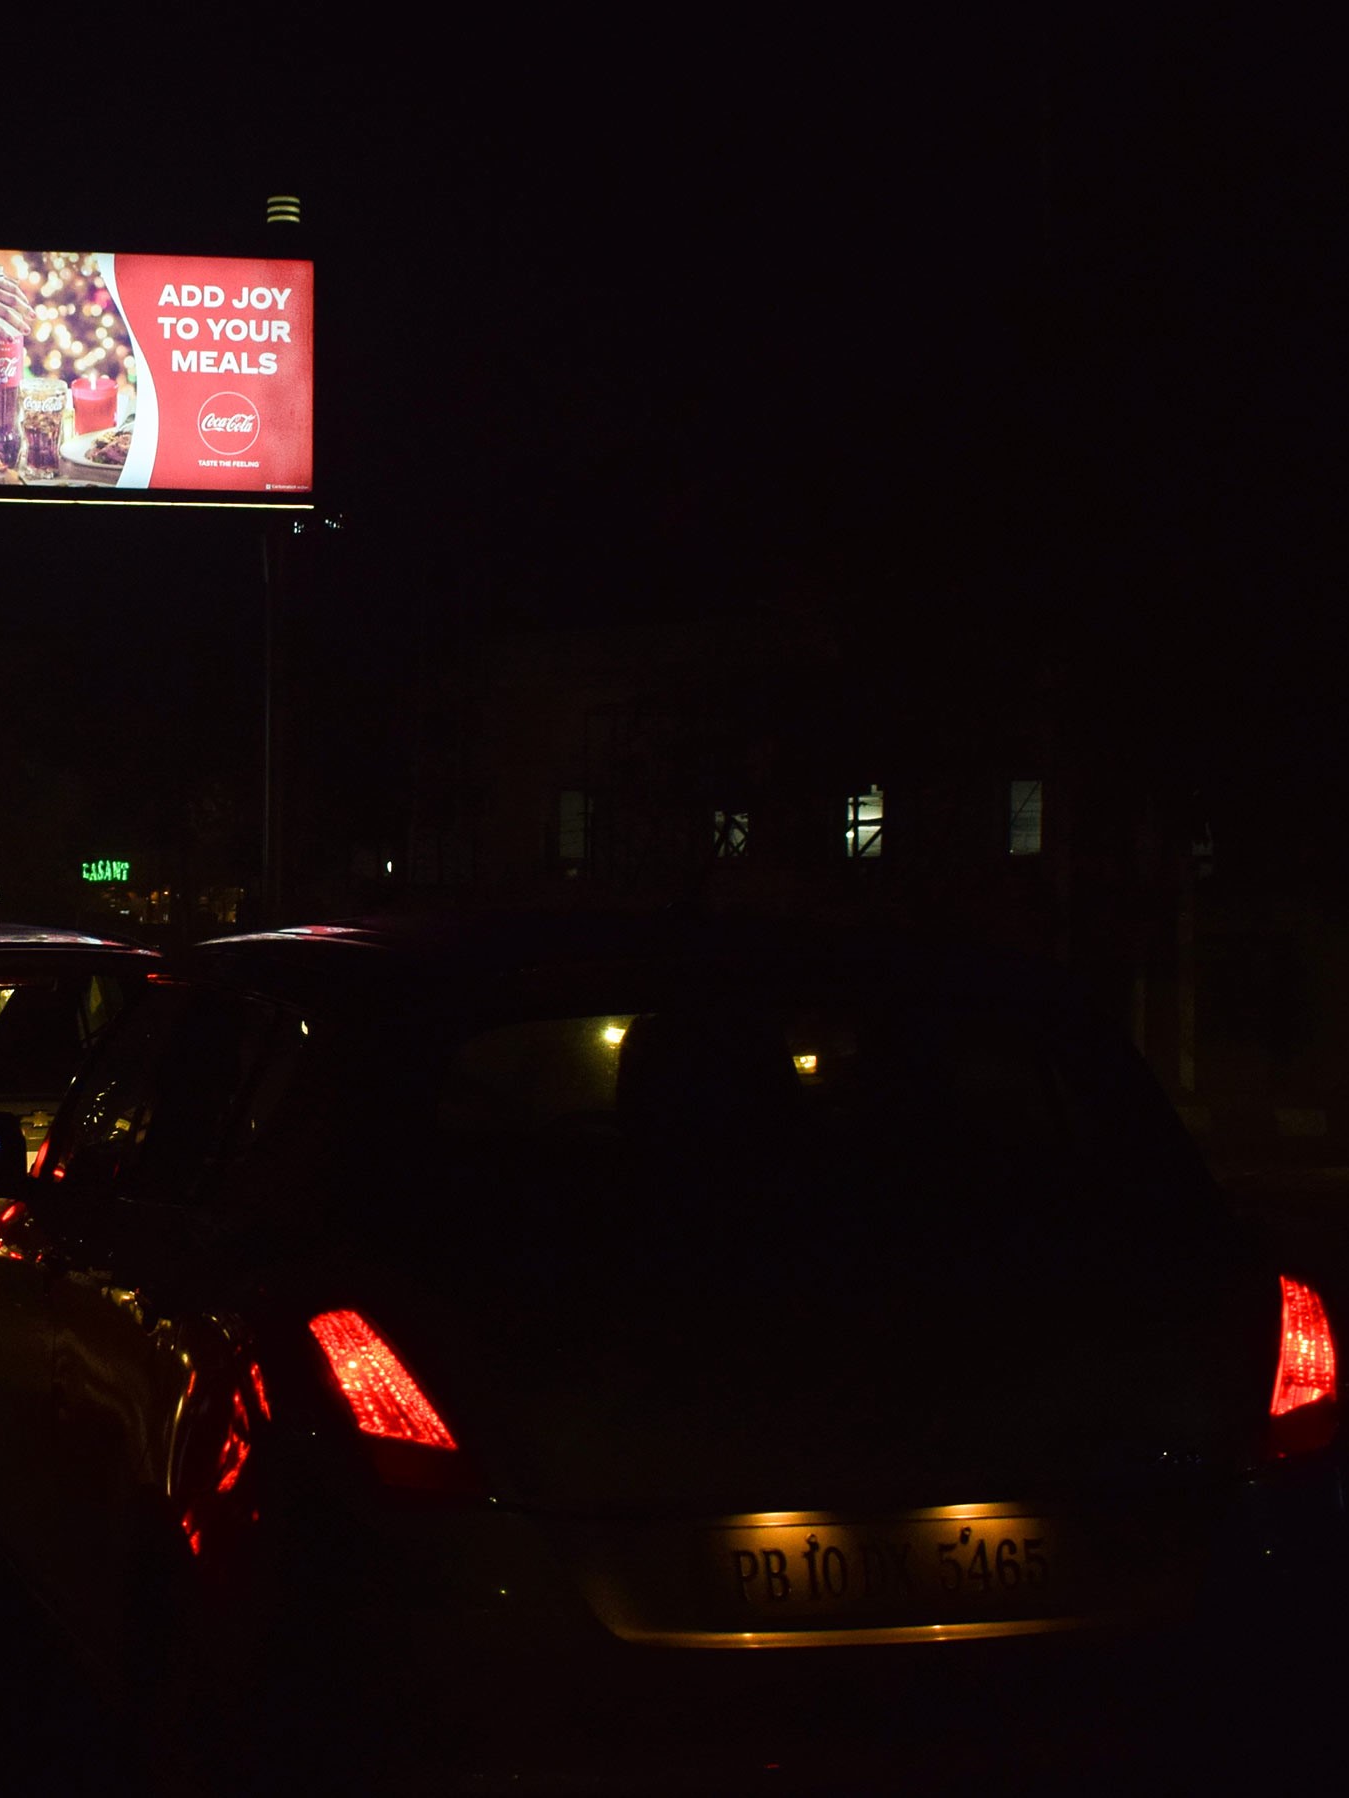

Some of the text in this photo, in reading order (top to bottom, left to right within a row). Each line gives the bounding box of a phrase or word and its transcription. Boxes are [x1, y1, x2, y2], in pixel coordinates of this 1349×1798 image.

[158, 284, 292, 310] ADD JOY
[157, 316, 292, 342] TO YOUR
[171, 350, 278, 374] MEALS
[198, 459, 218, 467] TASTE
[731, 1549, 791, 1601] PB
[801, 1544, 848, 1600] 10
[938, 1537, 1049, 1593] 5465
